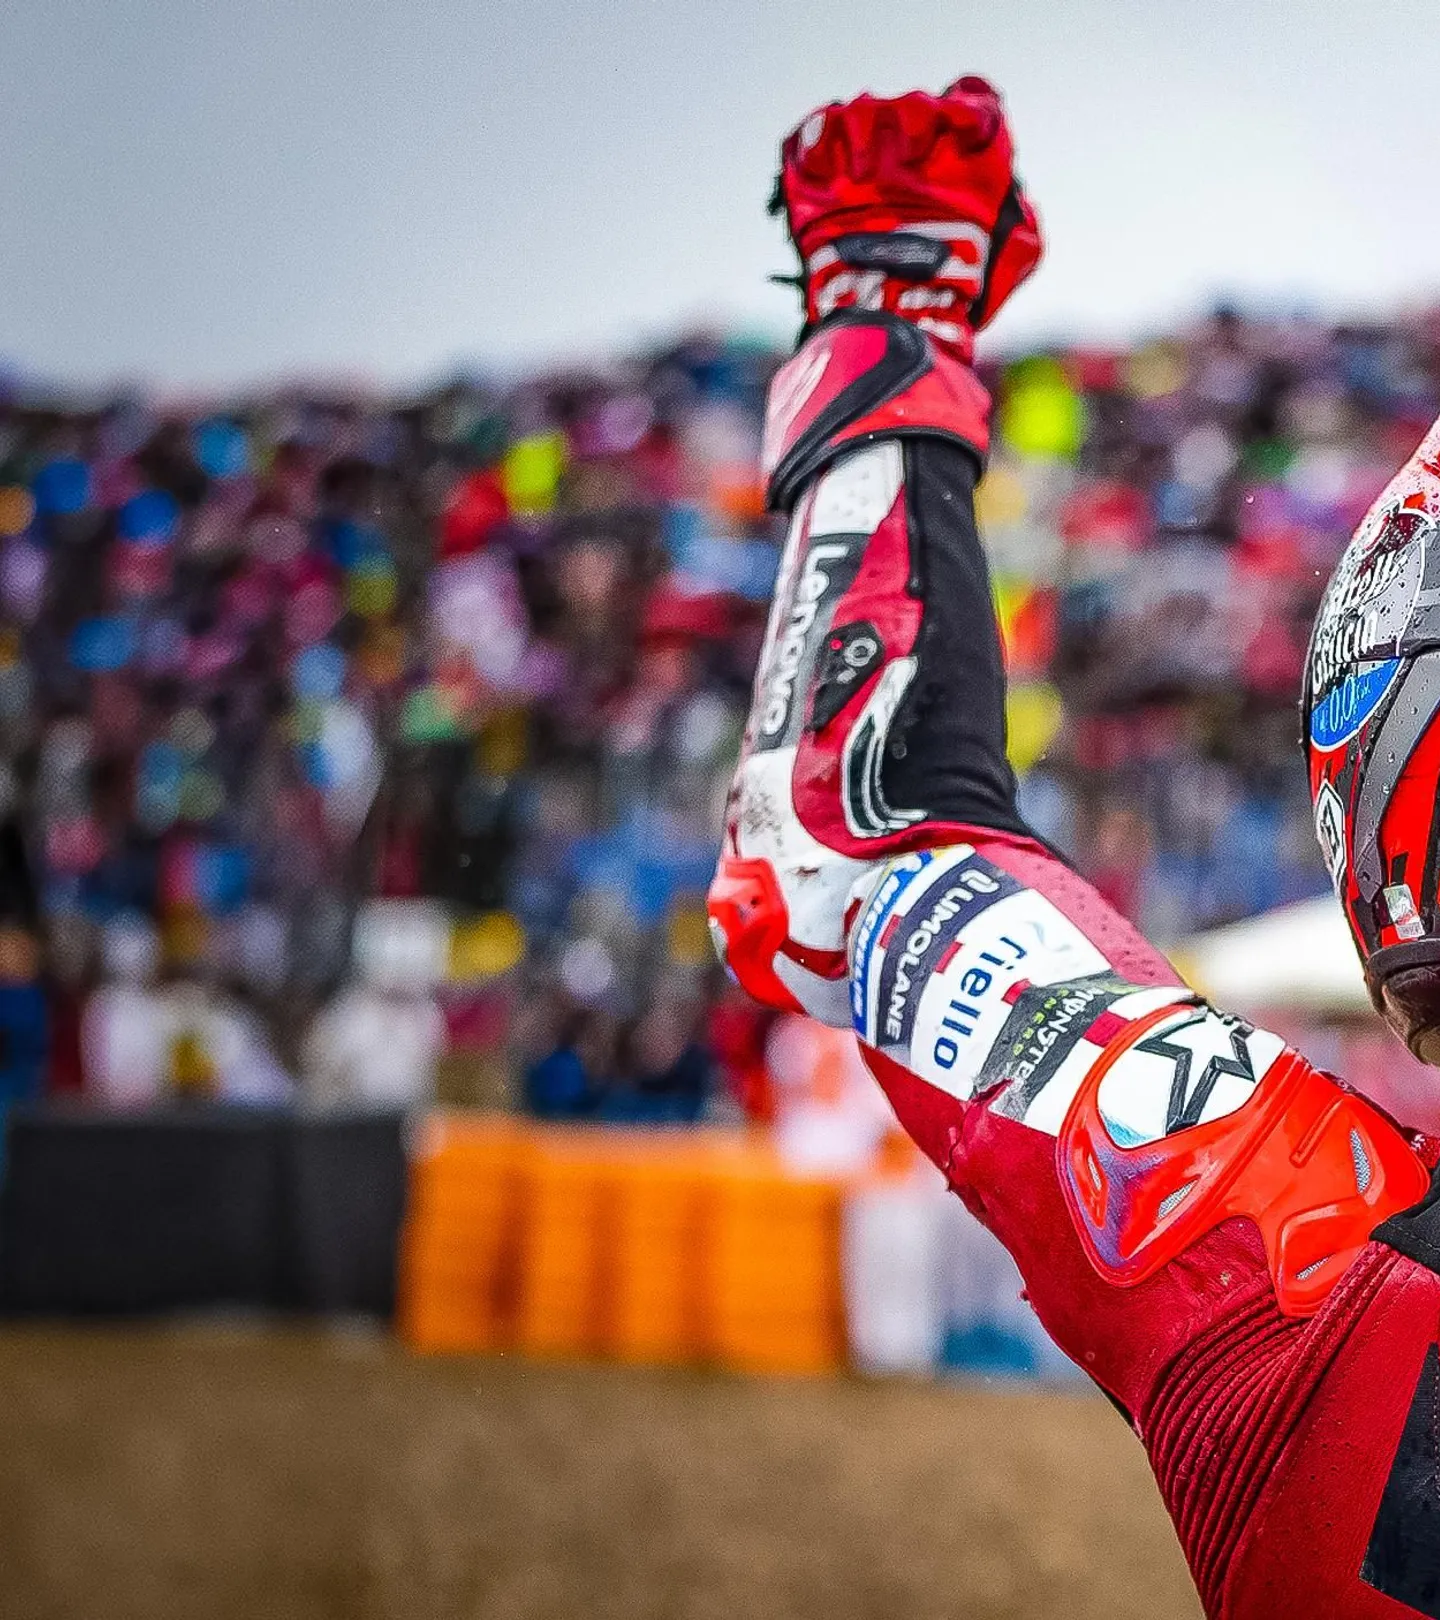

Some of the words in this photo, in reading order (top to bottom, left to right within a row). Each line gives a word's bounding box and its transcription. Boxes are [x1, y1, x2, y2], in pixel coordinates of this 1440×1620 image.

[760, 544, 850, 735] Lenovo
[934, 937, 1027, 1070] riello
[1010, 987, 1105, 1090] MONSTE
